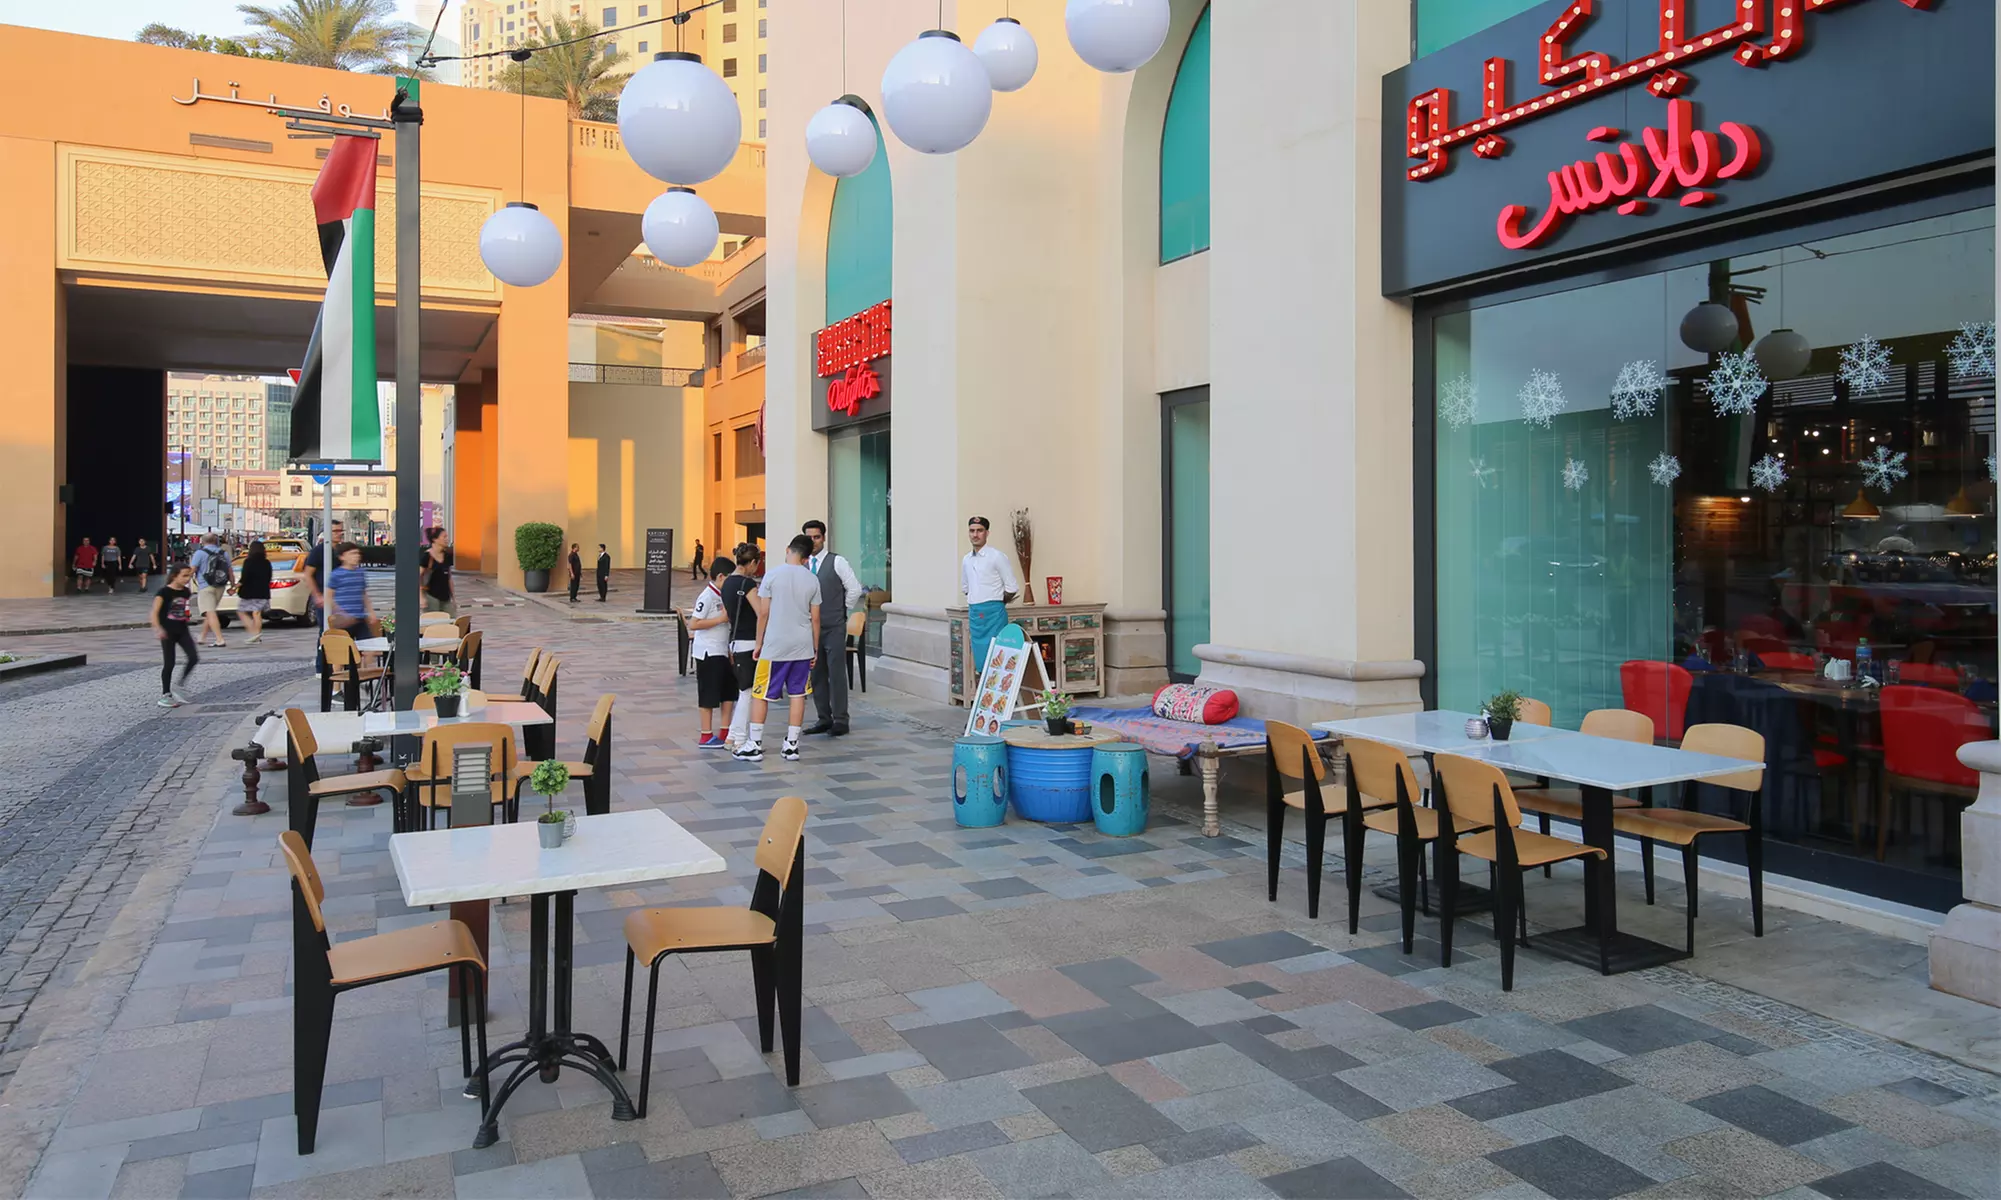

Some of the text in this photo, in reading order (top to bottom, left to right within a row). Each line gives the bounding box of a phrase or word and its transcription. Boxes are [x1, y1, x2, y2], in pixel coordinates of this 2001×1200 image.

[1497, 99, 1762, 249] ديلايتس
[828, 362, 880, 416] Delights
[695, 601, 704, 612] 3
